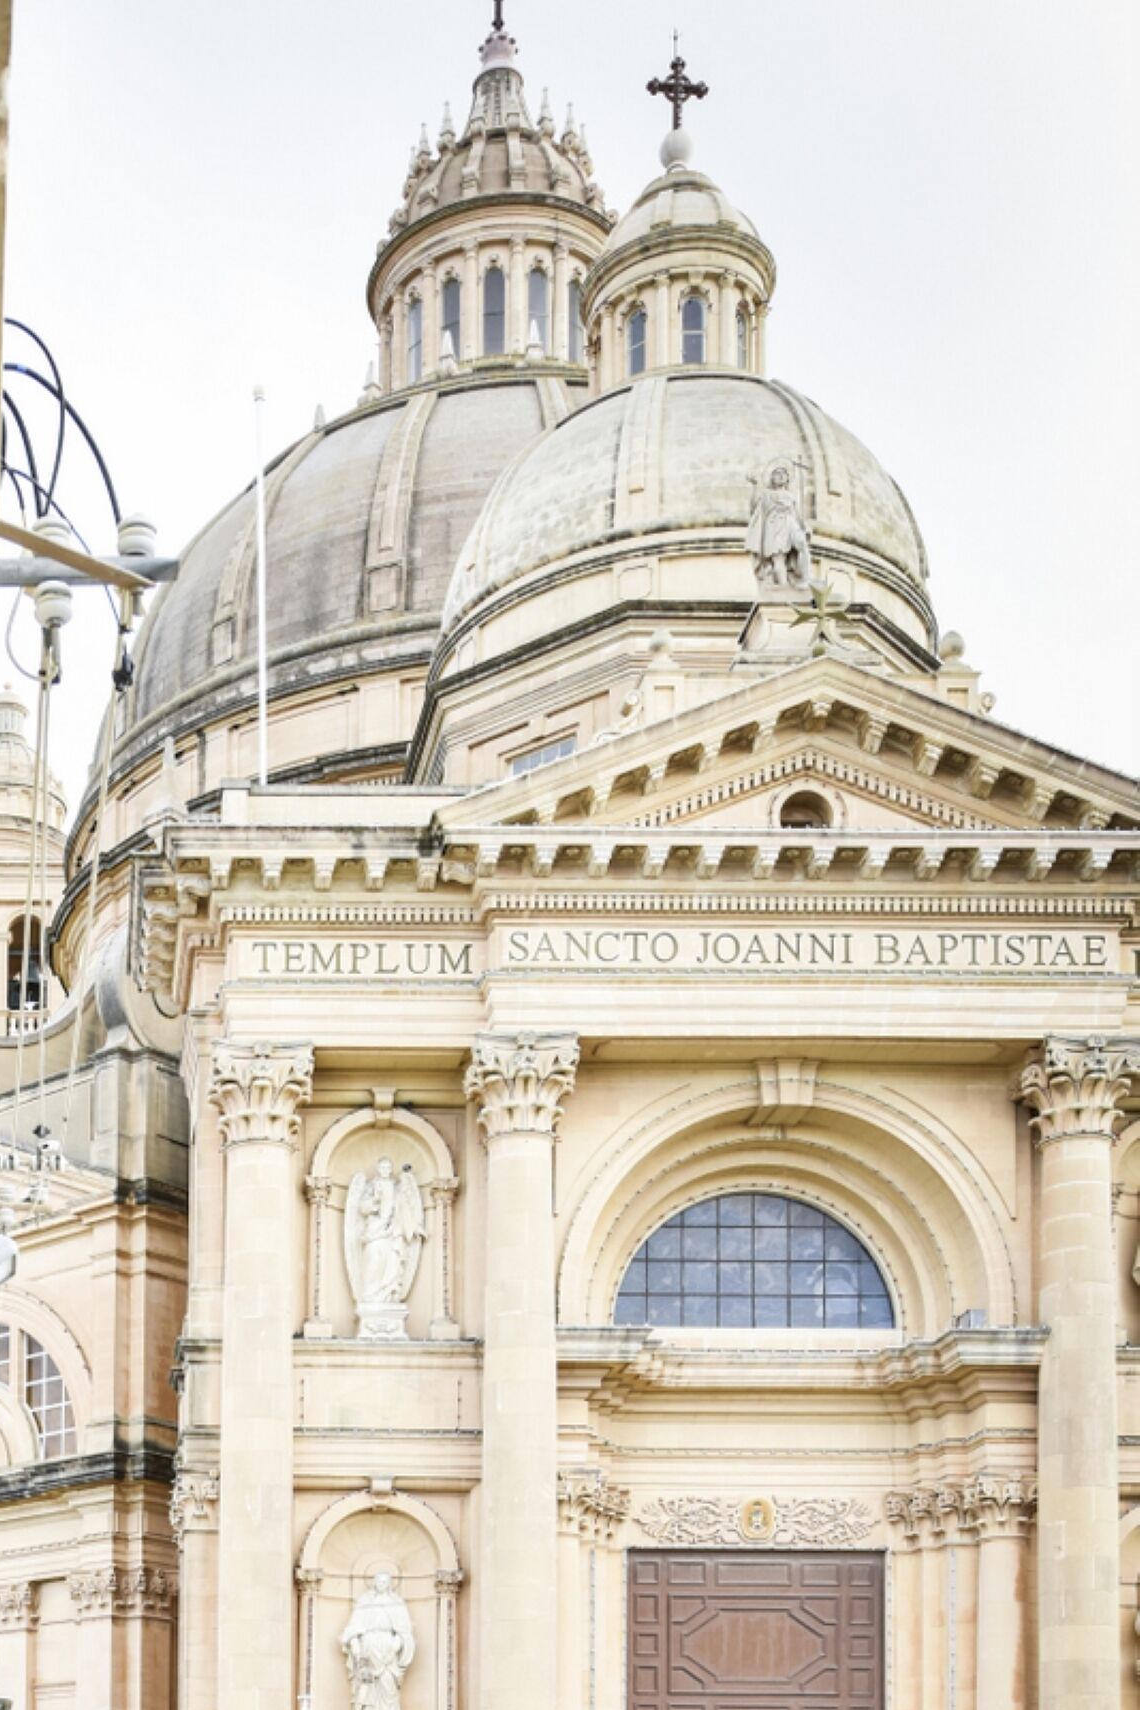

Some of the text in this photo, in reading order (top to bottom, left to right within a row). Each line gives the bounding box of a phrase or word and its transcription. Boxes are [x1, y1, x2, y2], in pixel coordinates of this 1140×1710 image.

[252, 930, 1108, 975] TEMPLUM SANCTO JOANNI BAPTISTAE
